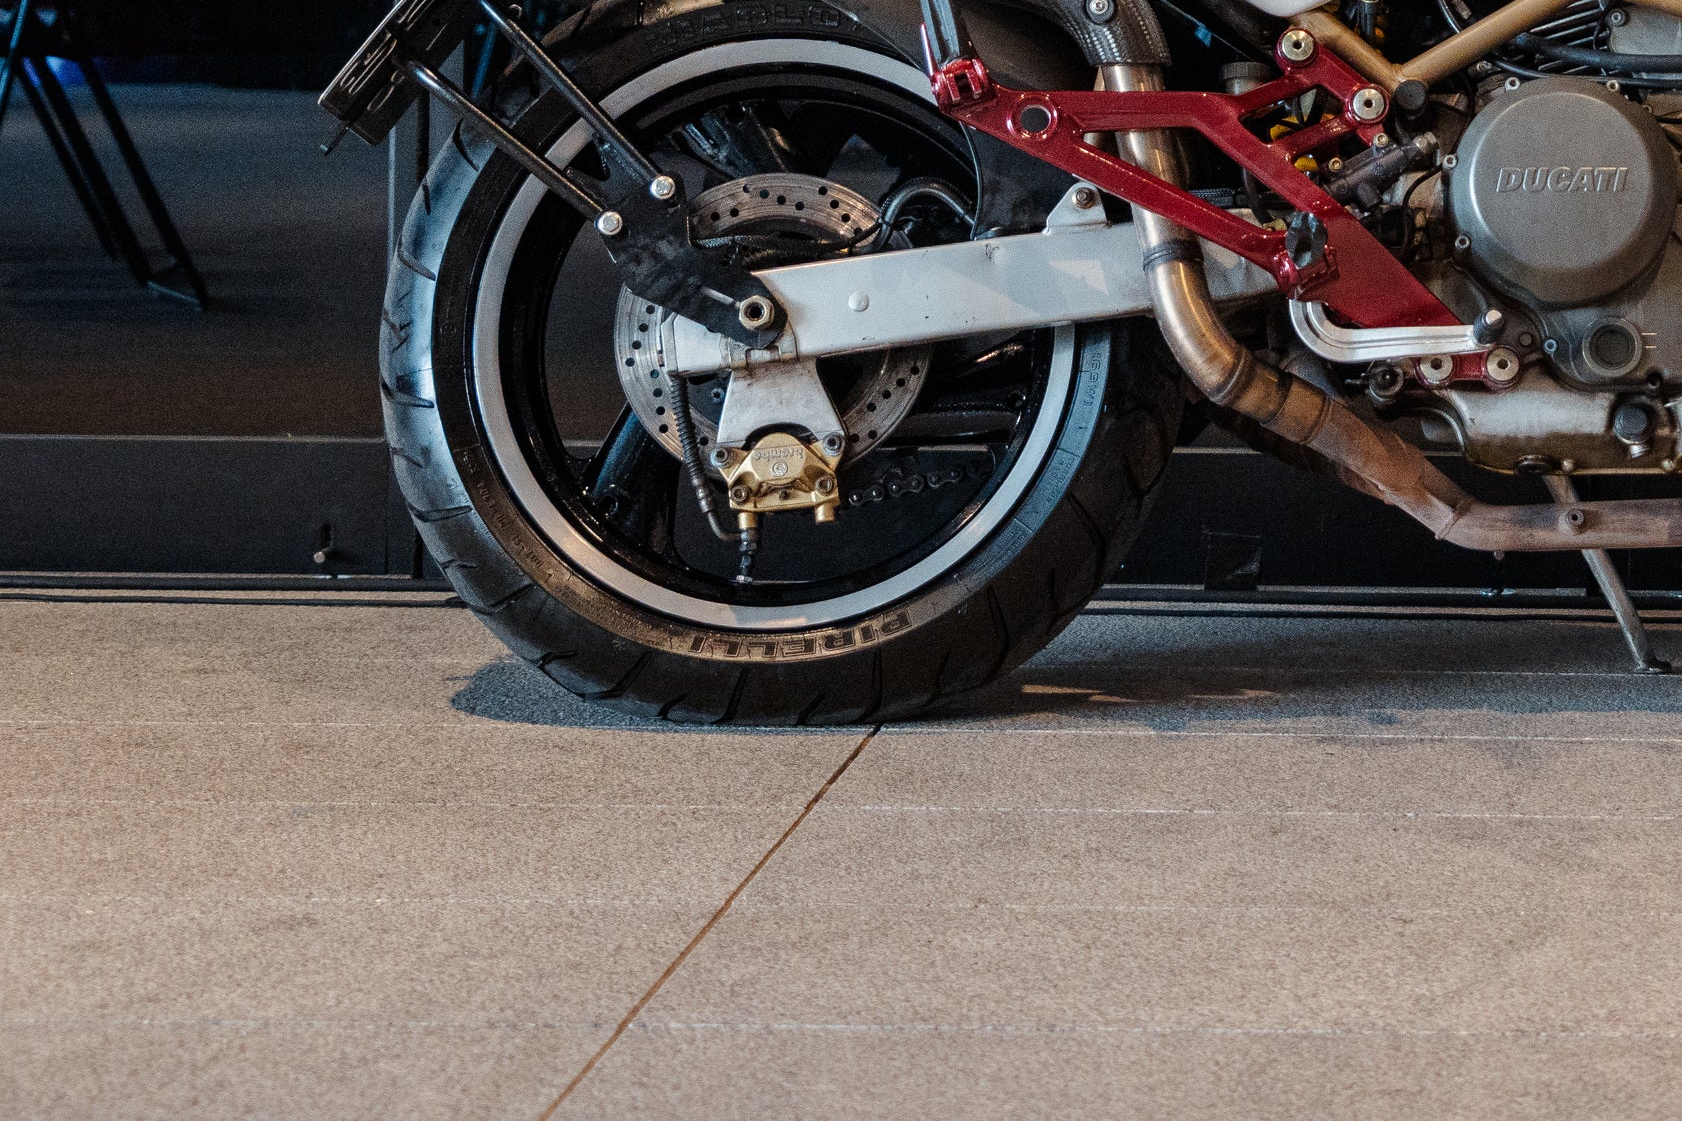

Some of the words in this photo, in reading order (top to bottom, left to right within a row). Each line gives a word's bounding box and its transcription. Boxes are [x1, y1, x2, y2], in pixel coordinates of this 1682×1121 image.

[1496, 166, 1629, 193] DUCATI
[753, 447, 804, 462] brembo
[688, 608, 912, 658] PIRELLI
